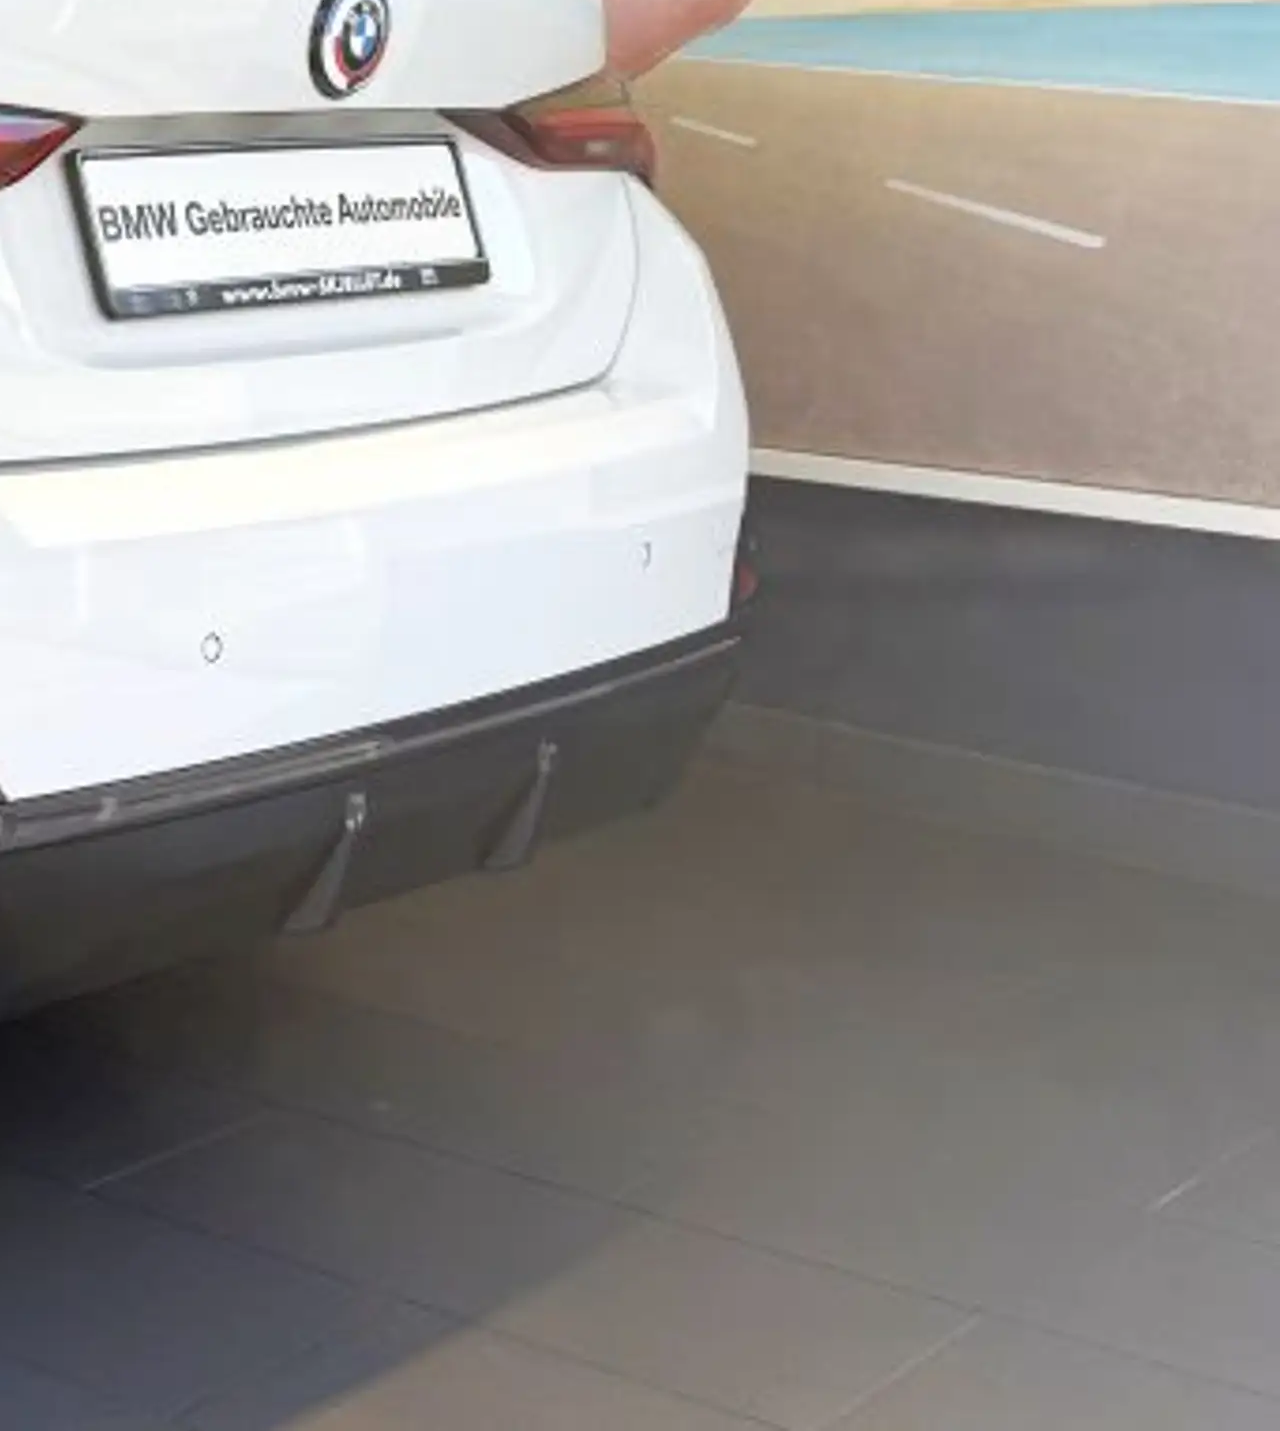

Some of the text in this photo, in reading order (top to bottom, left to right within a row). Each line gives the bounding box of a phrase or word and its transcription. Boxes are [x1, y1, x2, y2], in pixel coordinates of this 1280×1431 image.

[97, 188, 462, 242] BMW Gebrauchte Automobile
